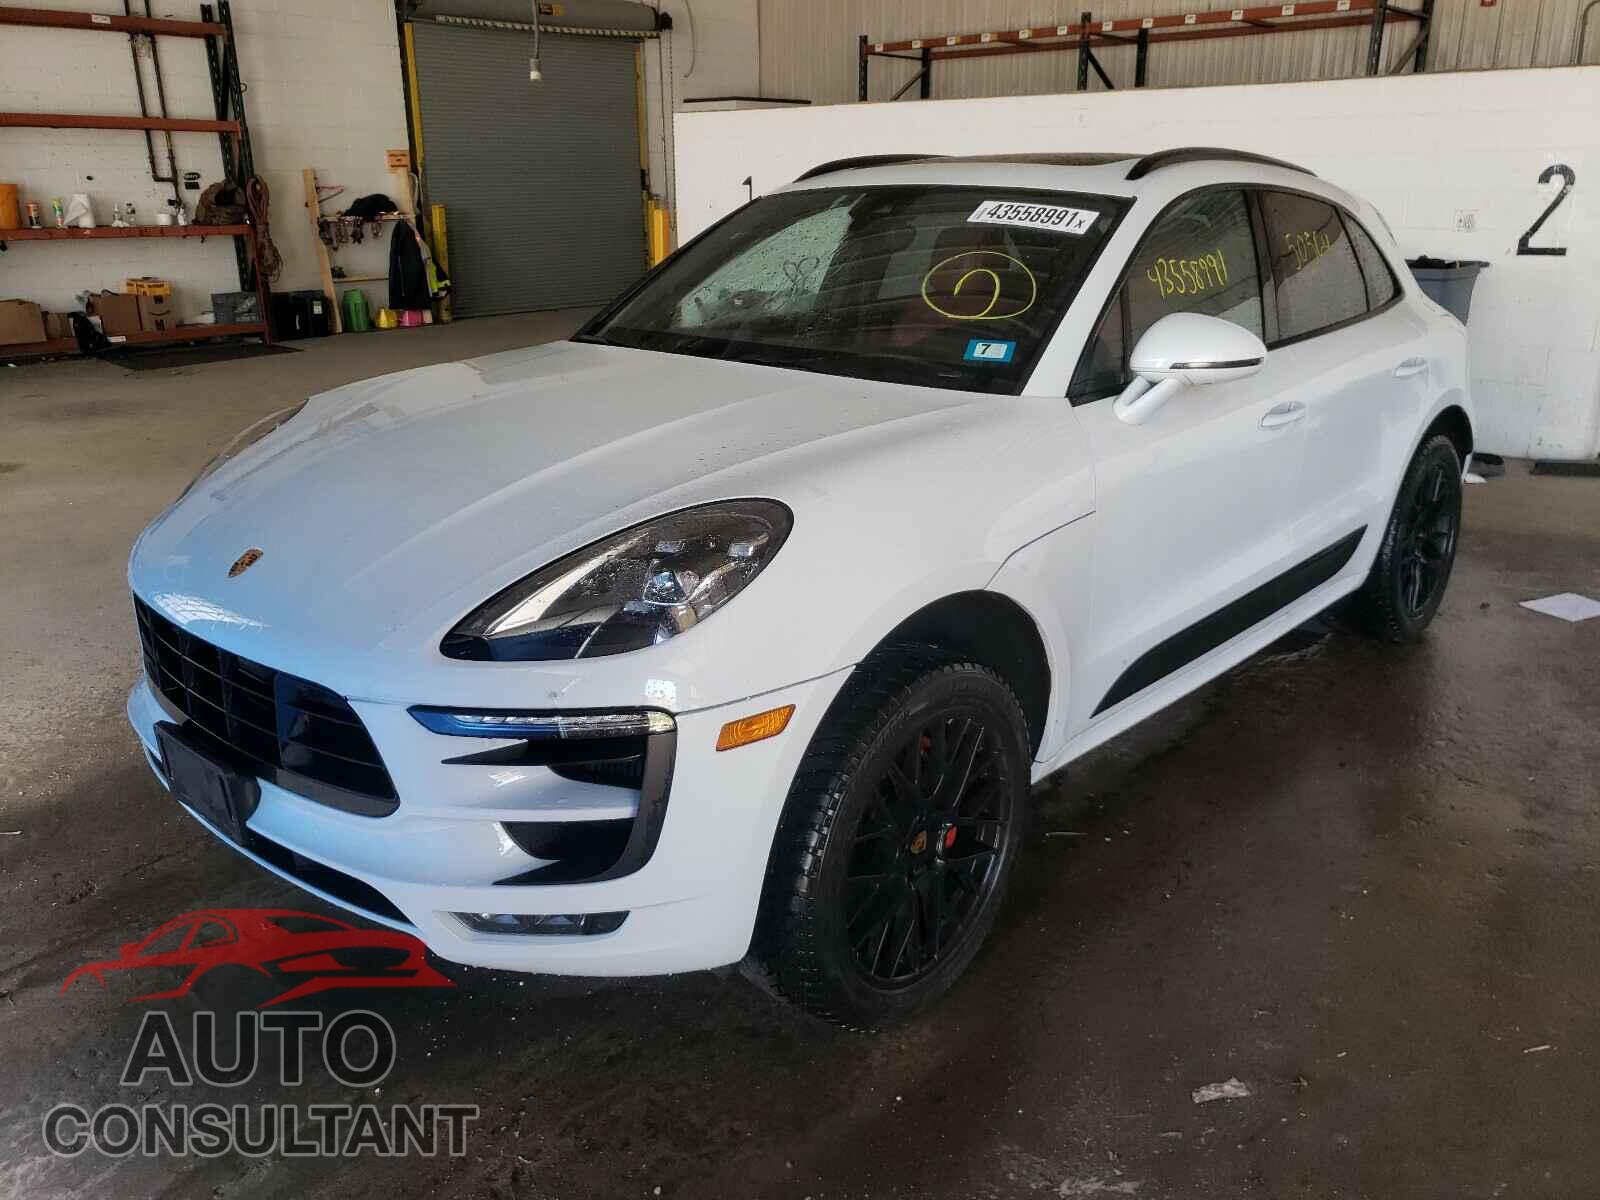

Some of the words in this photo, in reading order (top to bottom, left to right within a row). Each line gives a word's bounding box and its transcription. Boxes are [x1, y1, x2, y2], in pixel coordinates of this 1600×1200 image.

[986, 203, 1079, 227] 43558991
[1516, 164, 1575, 255] 2
[1147, 248, 1228, 298] 43558991
[981, 344, 991, 355] 7
